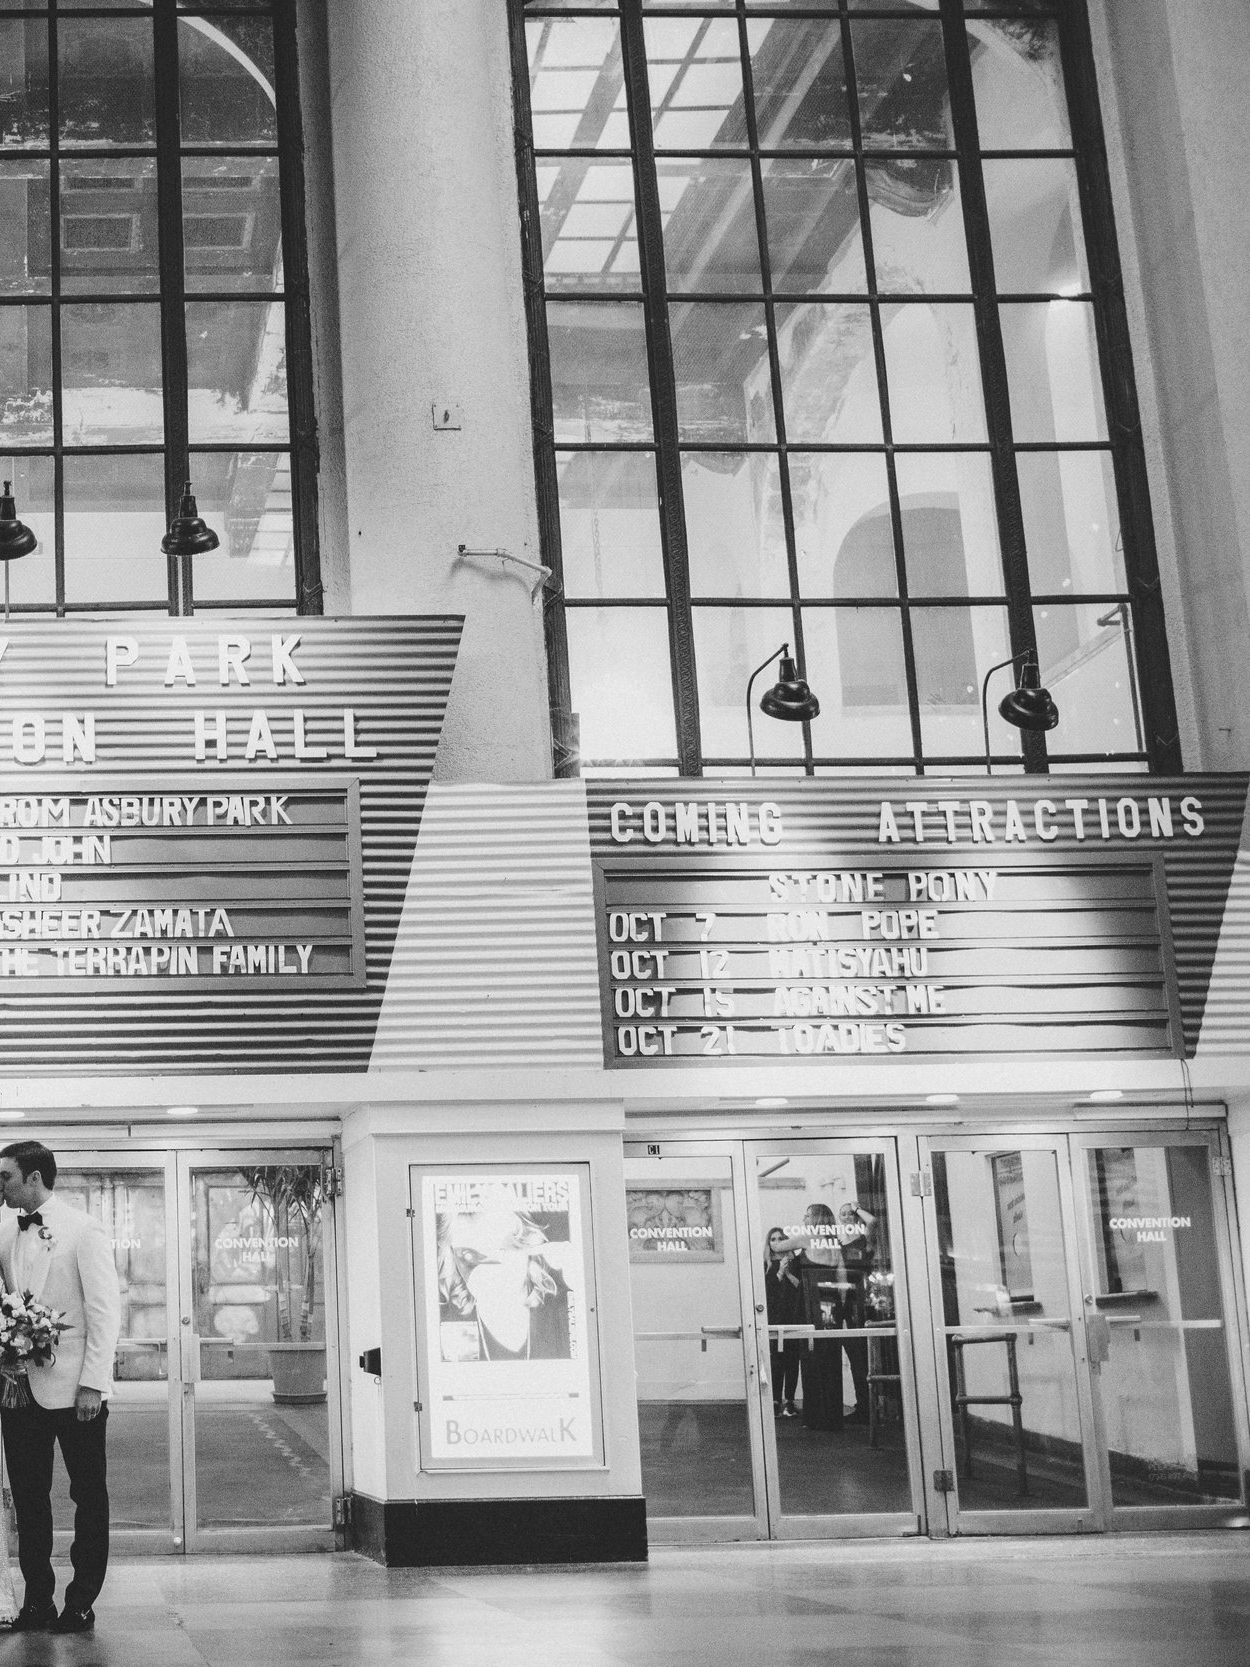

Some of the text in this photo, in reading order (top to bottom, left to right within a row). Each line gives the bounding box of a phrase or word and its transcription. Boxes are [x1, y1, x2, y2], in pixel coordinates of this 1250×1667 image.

[106, 633, 305, 686] PARK
[193, 708, 378, 761] HALL
[84, 796, 200, 827] ASBURY
[207, 796, 293, 827] PARK
[610, 797, 1206, 845] COMING ATTRACTIONS
[32, 835, 111, 865] JOHN
[768, 872, 998, 902] STONE PONY
[109, 908, 235, 938] ZAMATA
[609, 909, 940, 942] OCT 7 RON POPE
[50, 946, 199, 977] TERRAPIN
[212, 945, 314, 975] FAMILY
[611, 947, 929, 980] OCT 12 MATISYAHU
[615, 984, 946, 1018] OCT 15 AGAINST ME
[618, 1023, 907, 1056] OCT 21 TOADIES
[629, 1226, 713, 1239] CONVENTION
[783, 1223, 866, 1236] CONVENTION
[1109, 1216, 1192, 1230] CONVENTION
[1136, 1230, 1167, 1242] HALL
[214, 1236, 299, 1249] CONVENTION
[656, 1240, 689, 1252] HALL
[809, 1237, 842, 1250] HALL
